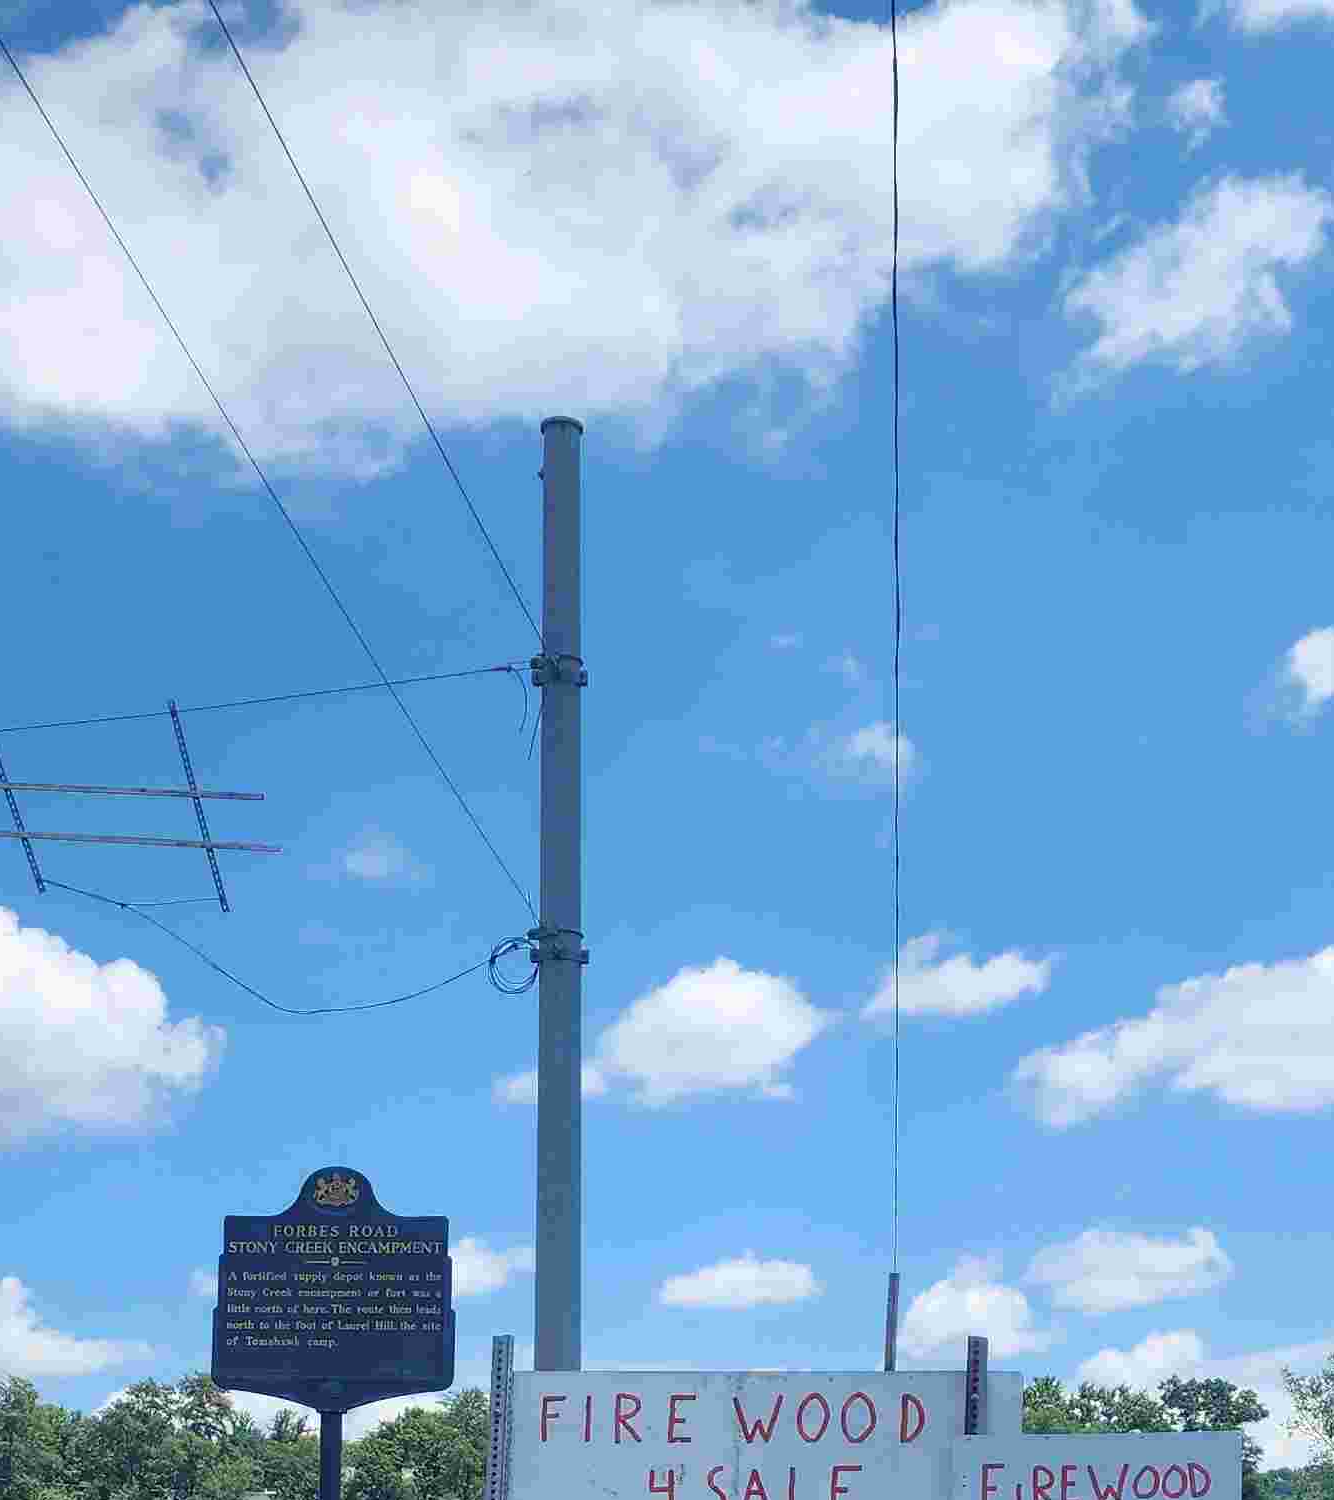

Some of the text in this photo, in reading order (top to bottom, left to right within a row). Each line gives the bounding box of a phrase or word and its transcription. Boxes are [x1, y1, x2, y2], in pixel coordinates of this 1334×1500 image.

[274, 1225, 398, 1238] FORBES ROAD
[228, 1240, 444, 1254] STONY CREEK ENCAMPMENT
[227, 1271, 238, 1281] A
[242, 1271, 287, 1281] fortified
[293, 1271, 327, 1284] supply
[332, 1271, 364, 1284] depot
[369, 1271, 403, 1281] known
[426, 1271, 443, 1281] the
[226, 1287, 257, 1300] Stony
[261, 1287, 292, 1297] Creek
[385, 1287, 407, 1297] fort
[226, 1303, 251, 1313] little
[254, 1303, 283, 1313] north
[287, 1303, 300, 1313] of
[331, 1303, 352, 1313] The
[357, 1304, 385, 1313] route
[389, 1303, 412, 1313] then
[226, 1319, 255, 1330] north
[259, 1320, 269, 1330] to
[274, 1319, 291, 1330] the
[295, 1319, 316, 1330] foot
[321, 1319, 333, 1330] of
[399, 1319, 417, 1330] the
[422, 1319, 442, 1330] site
[226, 1335, 238, 1346] of
[539, 1391, 928, 1443] FIRE WOOD
